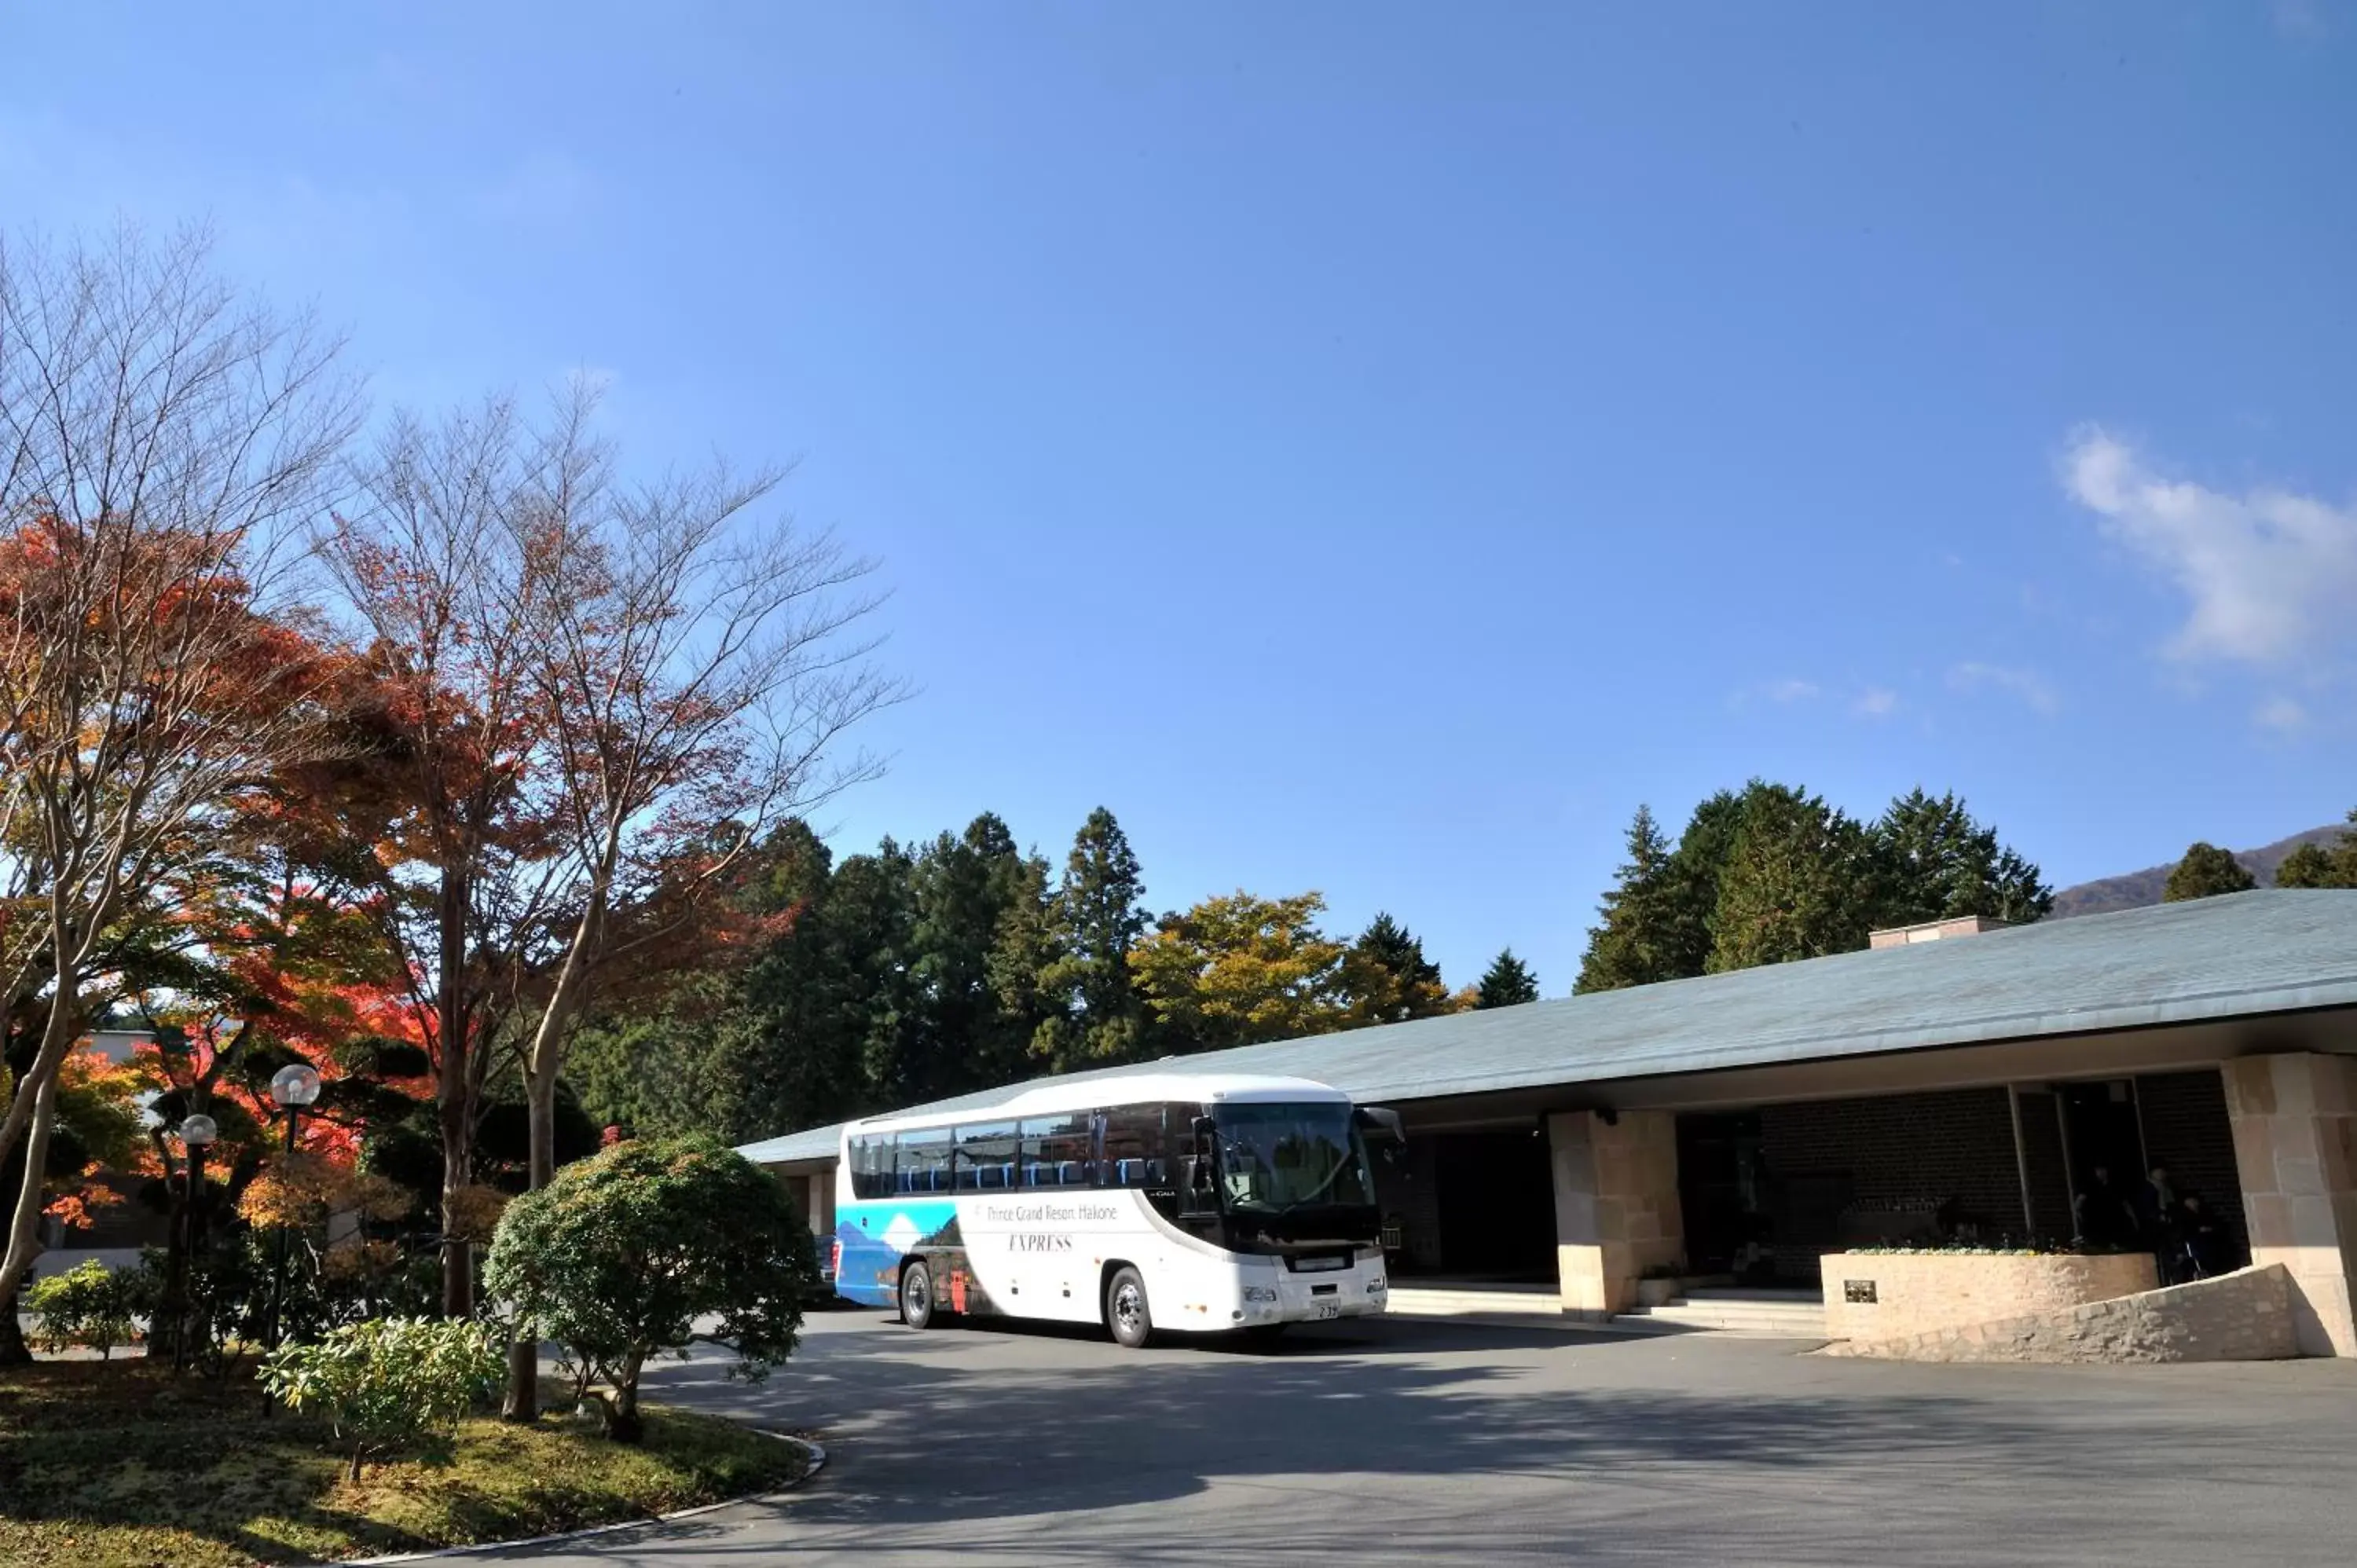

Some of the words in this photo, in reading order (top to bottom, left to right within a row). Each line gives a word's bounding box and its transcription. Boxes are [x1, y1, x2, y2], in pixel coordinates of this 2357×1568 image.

[988, 1206, 1014, 1222] Prince
[1016, 1206, 1043, 1222] Grand
[1046, 1204, 1076, 1220] Resort
[1079, 1204, 1117, 1220] Hakone
[1008, 1234, 1073, 1251] EXPRESS
